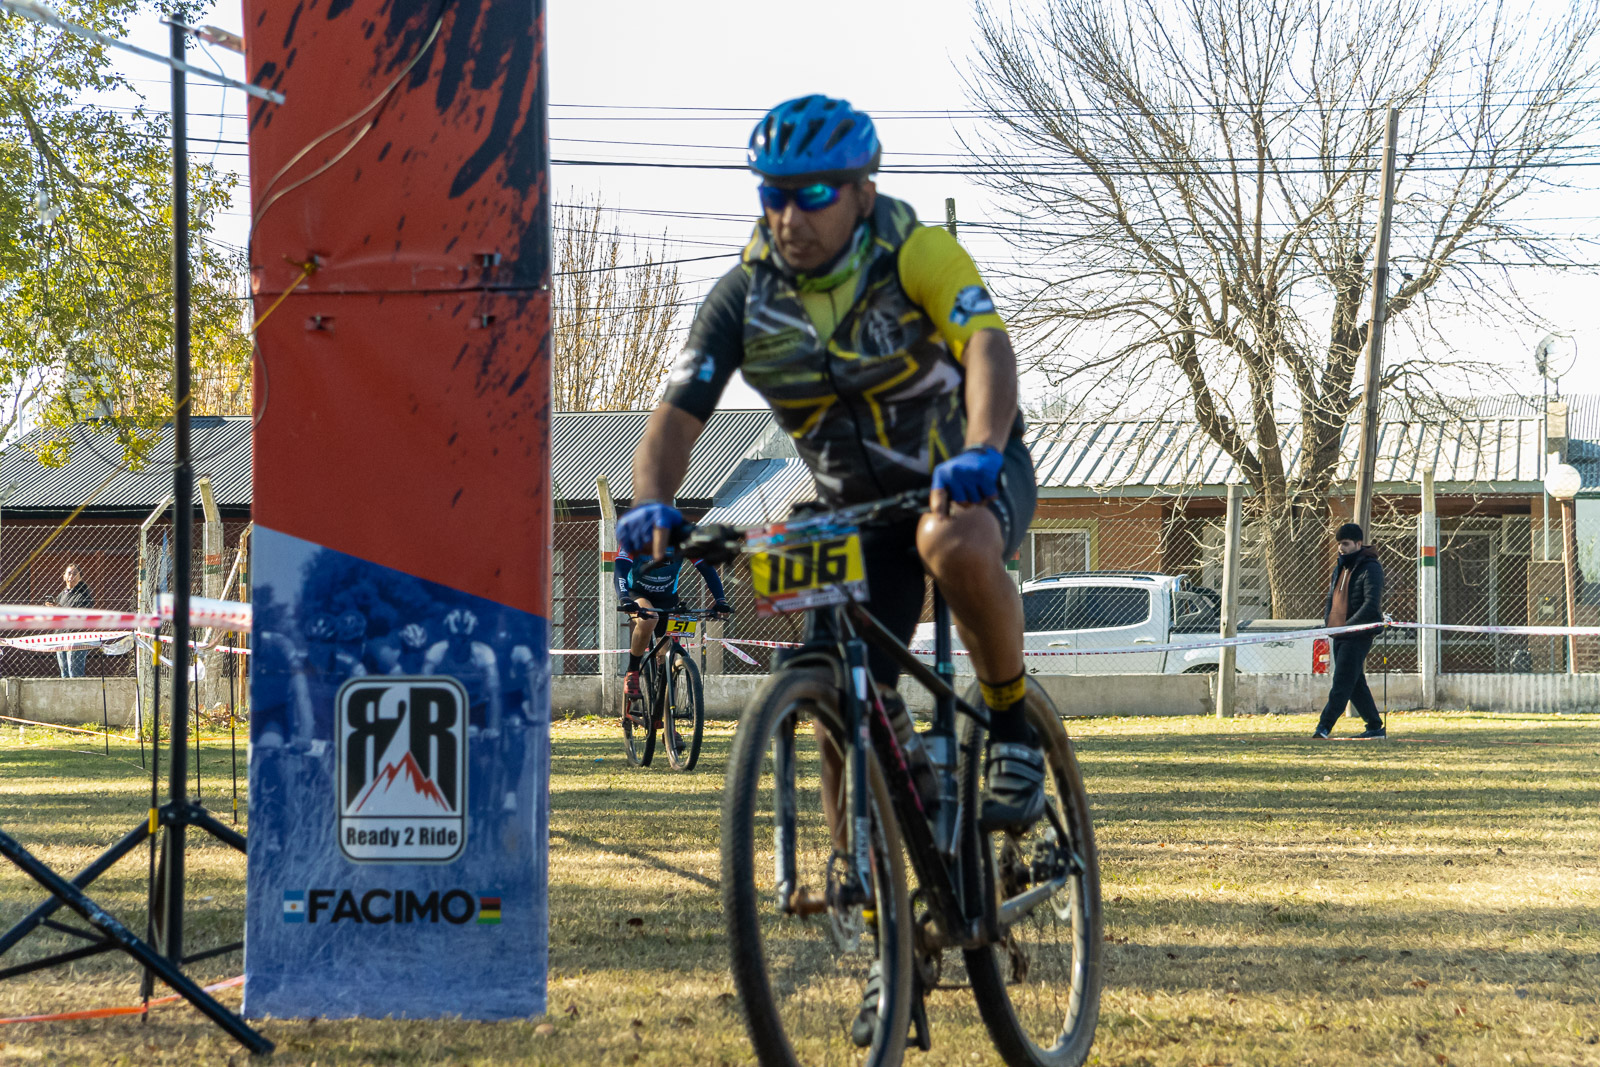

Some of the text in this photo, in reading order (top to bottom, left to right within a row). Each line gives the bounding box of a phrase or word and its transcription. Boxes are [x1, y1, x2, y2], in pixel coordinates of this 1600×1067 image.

[766, 540, 847, 593] 106
[672, 621, 690, 632] 51
[346, 827, 458, 848] Ready 2 Ride
[308, 889, 475, 924] FACIMO
